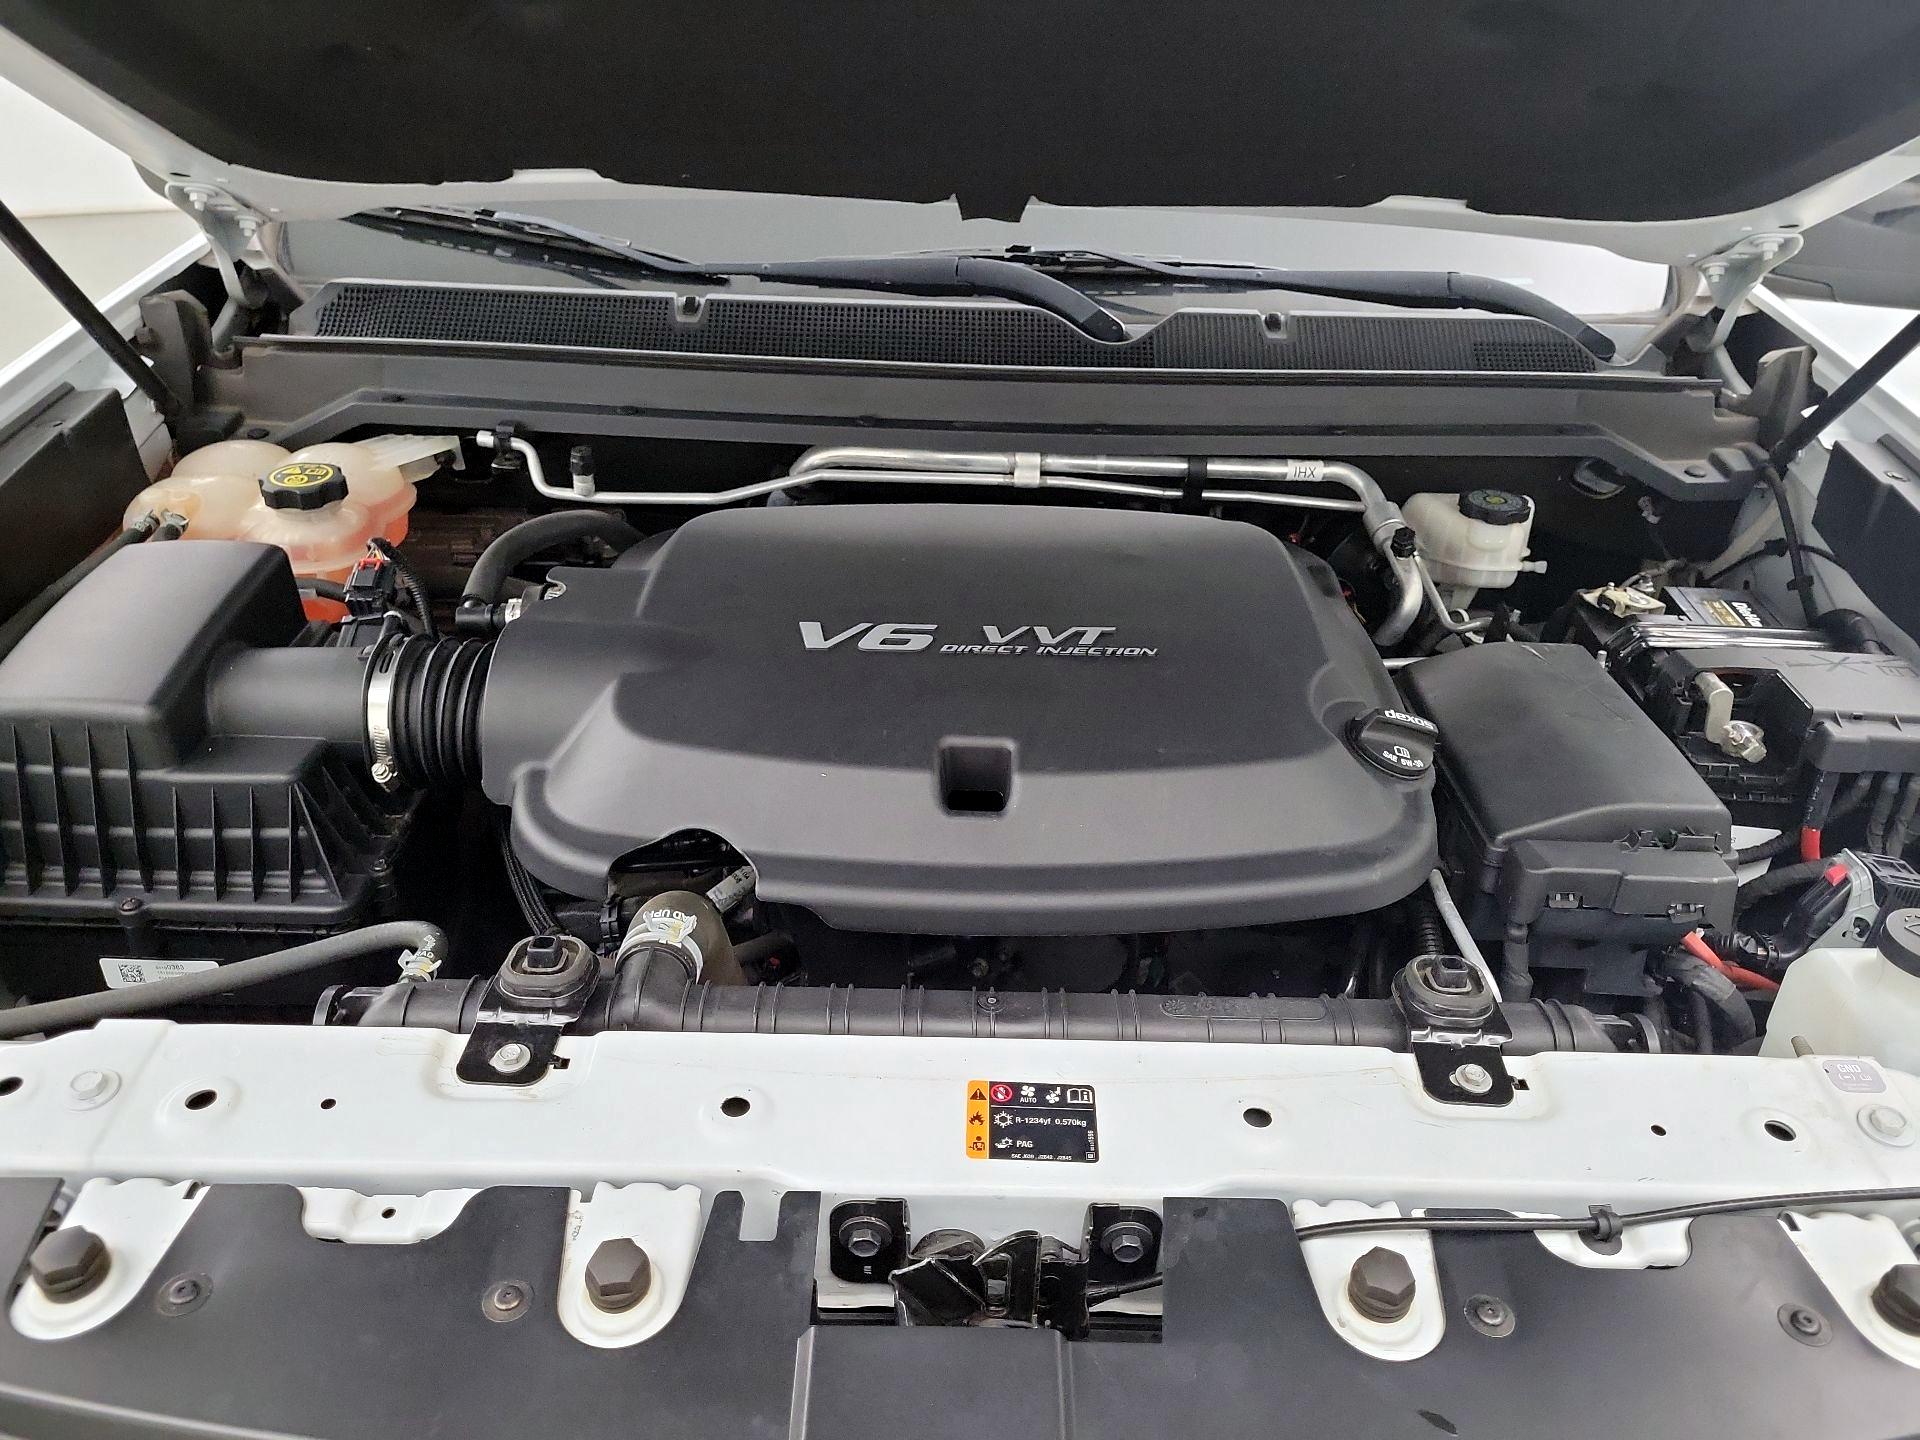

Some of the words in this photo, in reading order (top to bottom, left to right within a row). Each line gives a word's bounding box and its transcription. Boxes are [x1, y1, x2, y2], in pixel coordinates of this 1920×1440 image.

[799, 621, 938, 650] V6
[982, 625, 1116, 645] VVT
[940, 644, 1028, 656] DIRECT
[1035, 645, 1158, 657] INJECTION
[1384, 709, 1435, 730] dexos
[1382, 750, 1398, 763] SAE
[1836, 1063, 1861, 1073] GND
[1015, 1116, 1051, 1125] R-1234yf
[1055, 1118, 1087, 1127] 0.570kg
[1016, 1140, 1034, 1148] PAG
